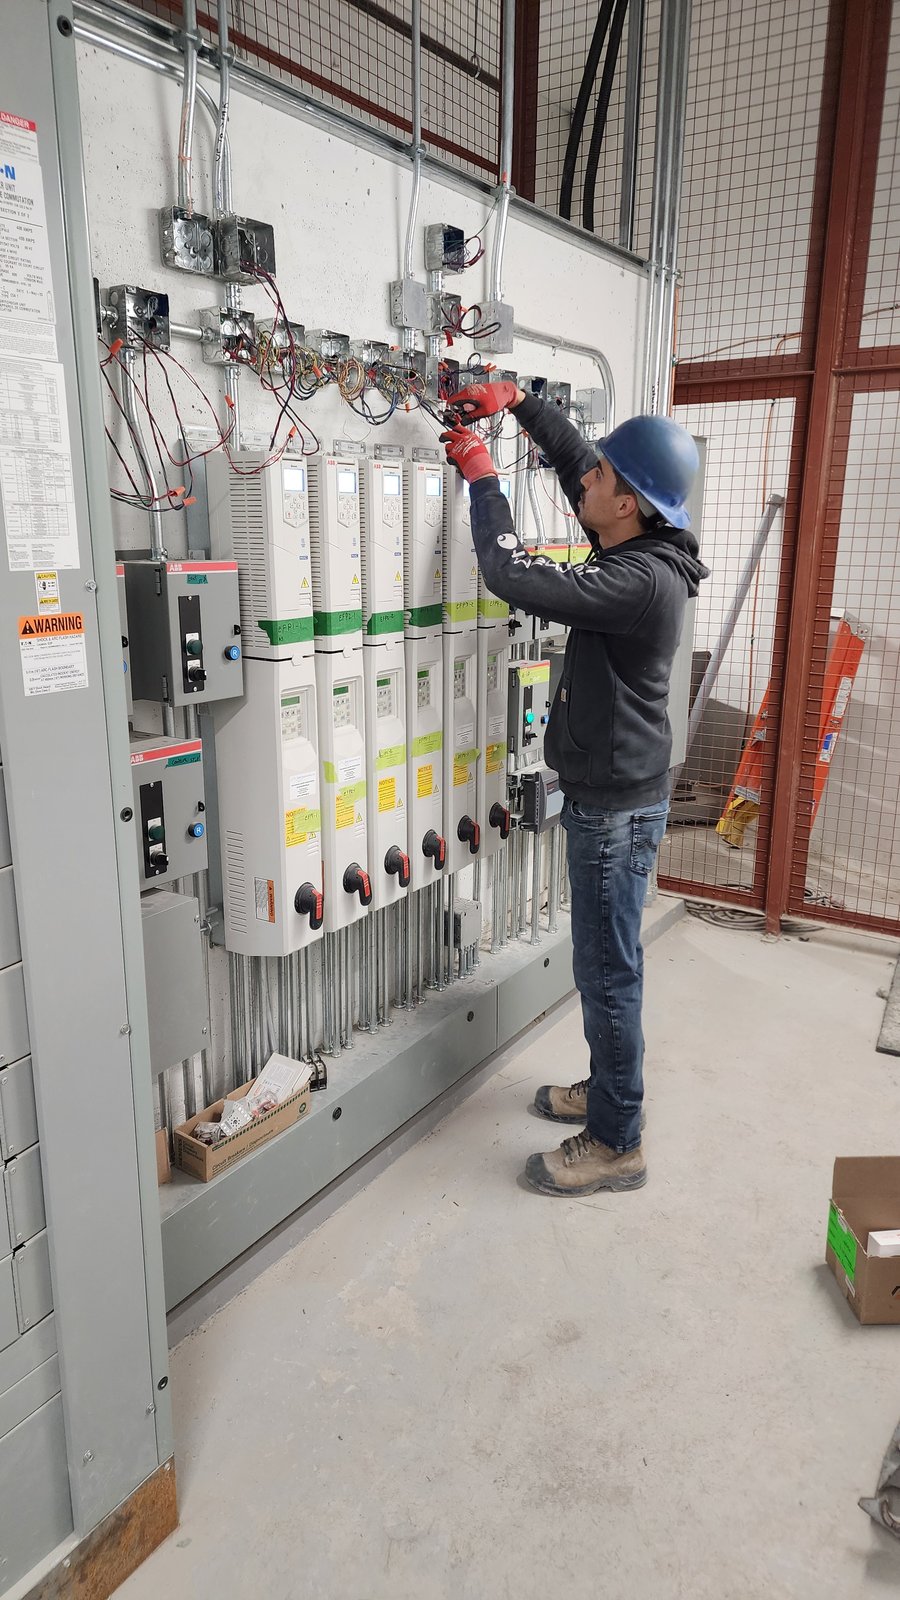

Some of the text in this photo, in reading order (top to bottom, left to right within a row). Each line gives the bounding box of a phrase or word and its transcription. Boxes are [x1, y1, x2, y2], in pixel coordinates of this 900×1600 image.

[0, 112, 30, 128] DANGER
[34, 616, 82, 633] WARNING
[131, 755, 144, 763] ABB
